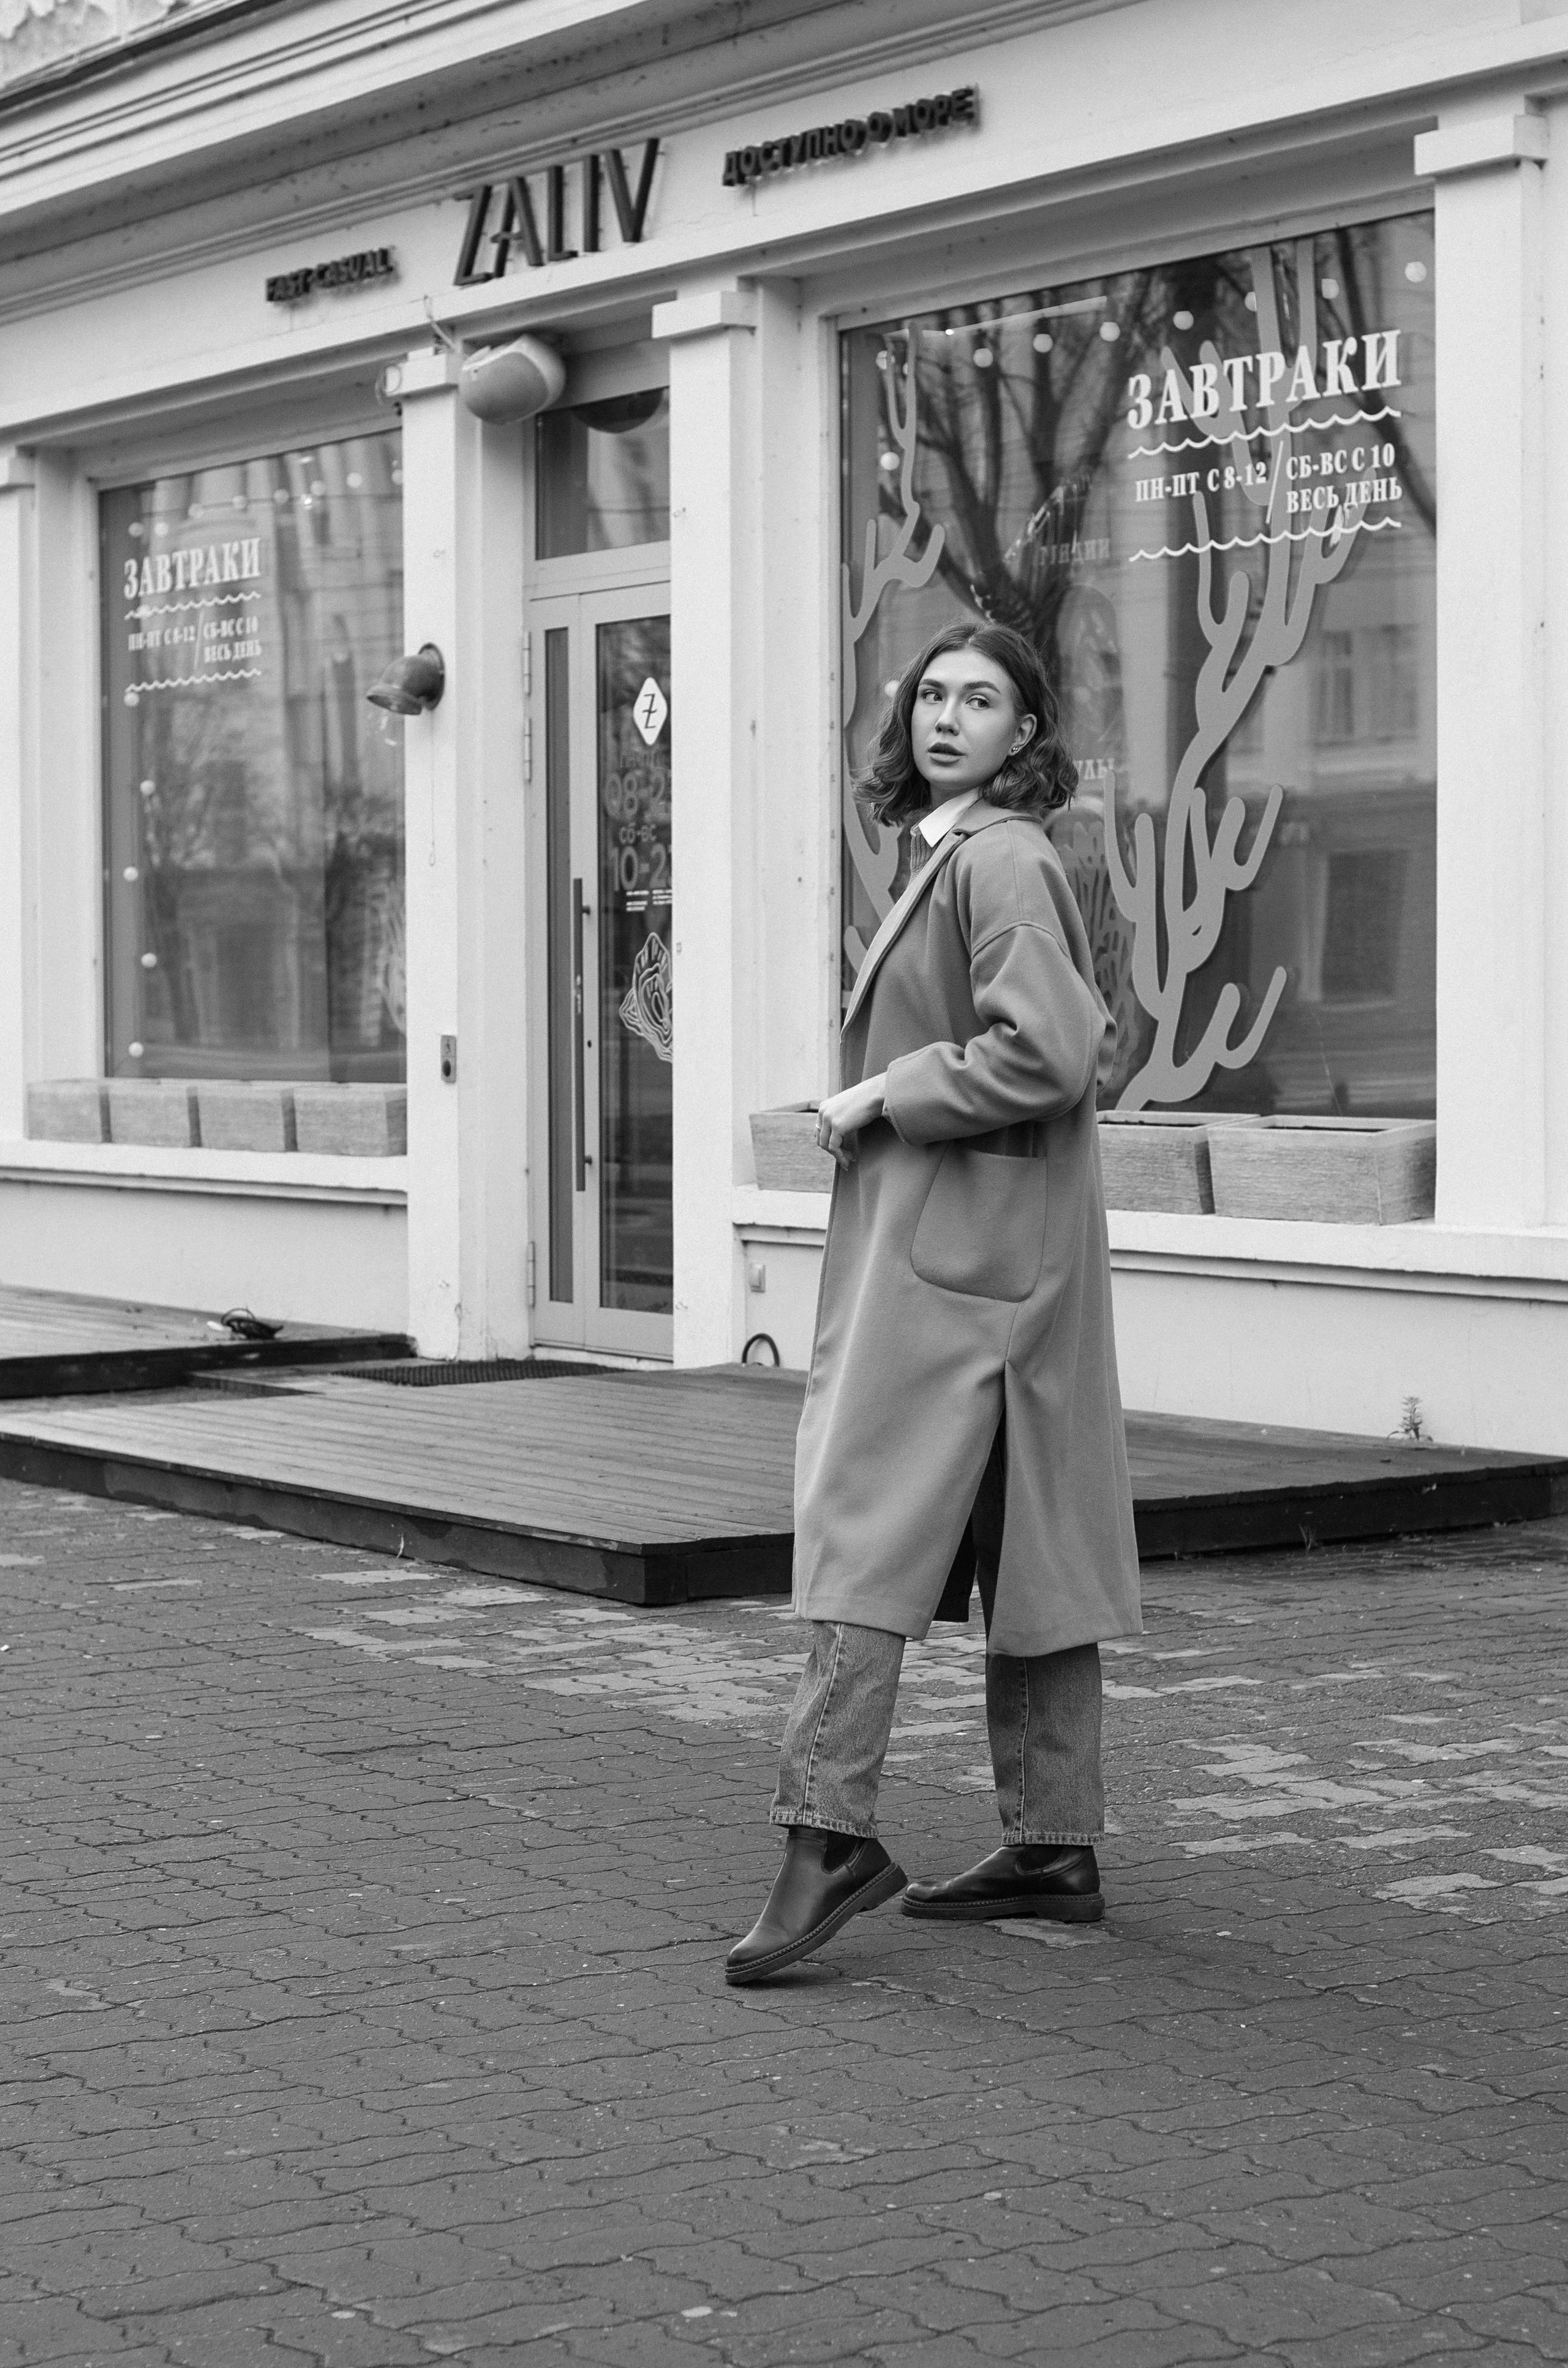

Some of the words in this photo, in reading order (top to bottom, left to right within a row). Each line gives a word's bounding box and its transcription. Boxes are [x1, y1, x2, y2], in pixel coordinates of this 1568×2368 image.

[722, 119, 867, 186] ДОСТУПНО
[867, 111, 894, 143] О
[892, 86, 975, 137] МОРЕ
[453, 138, 660, 286] ZALIV
[316, 247, 394, 289] CASUAL
[1127, 329, 1401, 429] ЗАВТРАКИ
[1136, 471, 1200, 501] ПН-ПТ
[1207, 468, 1219, 492] С
[1224, 461, 1267, 489] 8-12
[1287, 449, 1348, 480] СБ-ВС
[1352, 447, 1365, 471] С
[1370, 443, 1395, 468] 10
[1287, 485, 1340, 513] ВЕСЬ
[1344, 476, 1403, 509] ДЕНЬ
[124, 537, 261, 600] ЗАВТРАКИ
[603, 771, 671, 820] 08-2
[612, 842, 671, 891] 10-2
